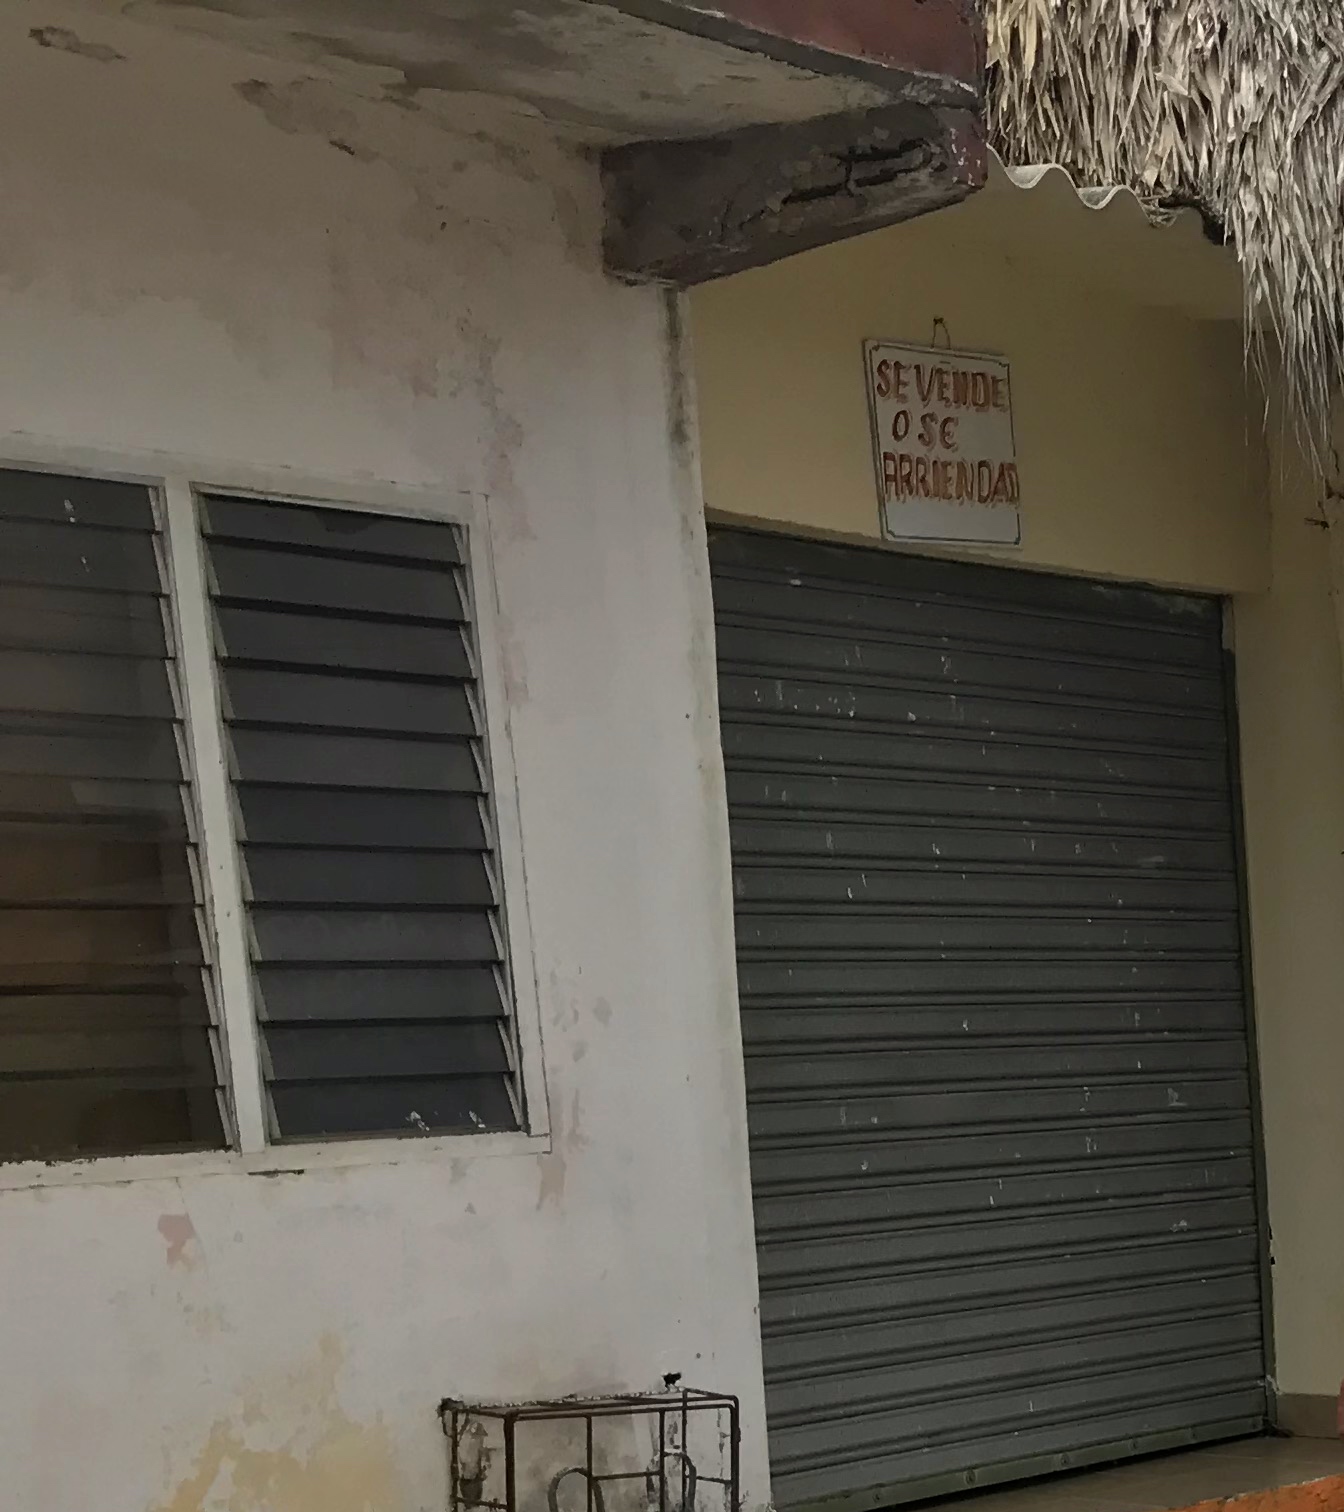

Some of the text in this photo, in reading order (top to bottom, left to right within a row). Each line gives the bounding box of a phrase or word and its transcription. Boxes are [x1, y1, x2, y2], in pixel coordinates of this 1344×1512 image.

[876, 358, 1008, 410] SE VENDE
[892, 409, 959, 451] O SE
